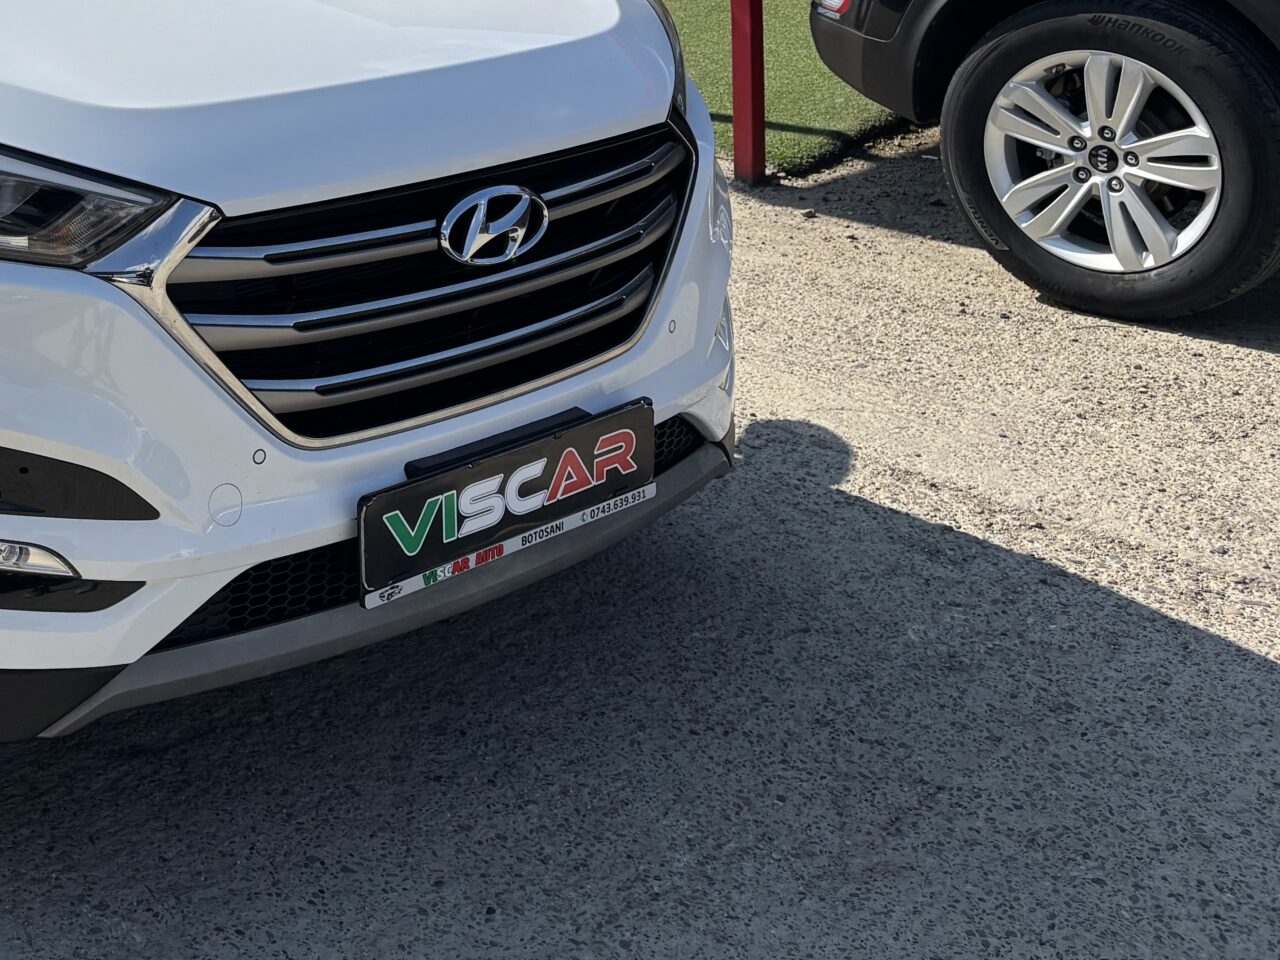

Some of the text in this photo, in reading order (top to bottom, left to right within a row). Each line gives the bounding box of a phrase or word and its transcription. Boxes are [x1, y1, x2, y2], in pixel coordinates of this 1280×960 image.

[1097, 148, 1108, 171] KIA
[382, 428, 638, 557] VISCAR
[422, 489, 647, 587] VISCAR AUTO BOTOSANI 0743.639.931
